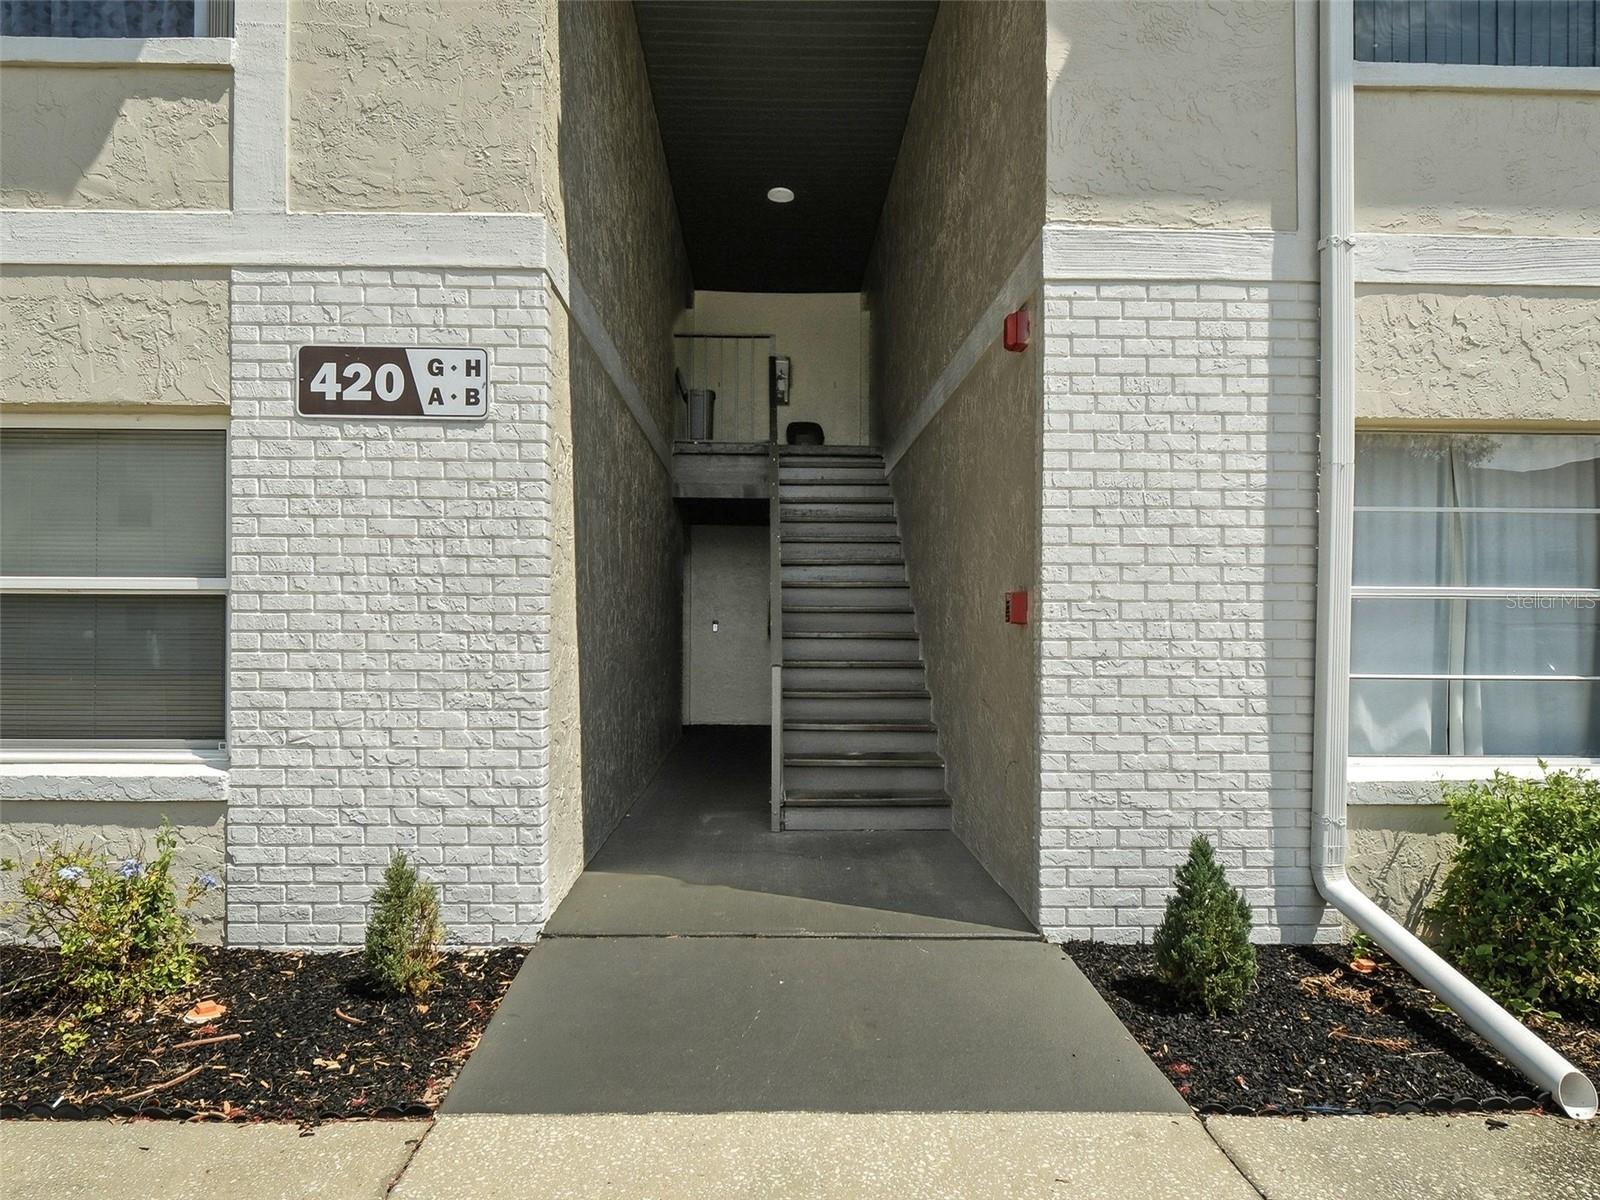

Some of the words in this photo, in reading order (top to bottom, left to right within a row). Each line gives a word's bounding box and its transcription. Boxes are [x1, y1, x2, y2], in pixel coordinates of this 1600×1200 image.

[427, 358, 444, 377] G
[465, 359, 481, 377] H
[310, 362, 405, 402] 420
[427, 387, 444, 406] A
[465, 387, 481, 406] B
